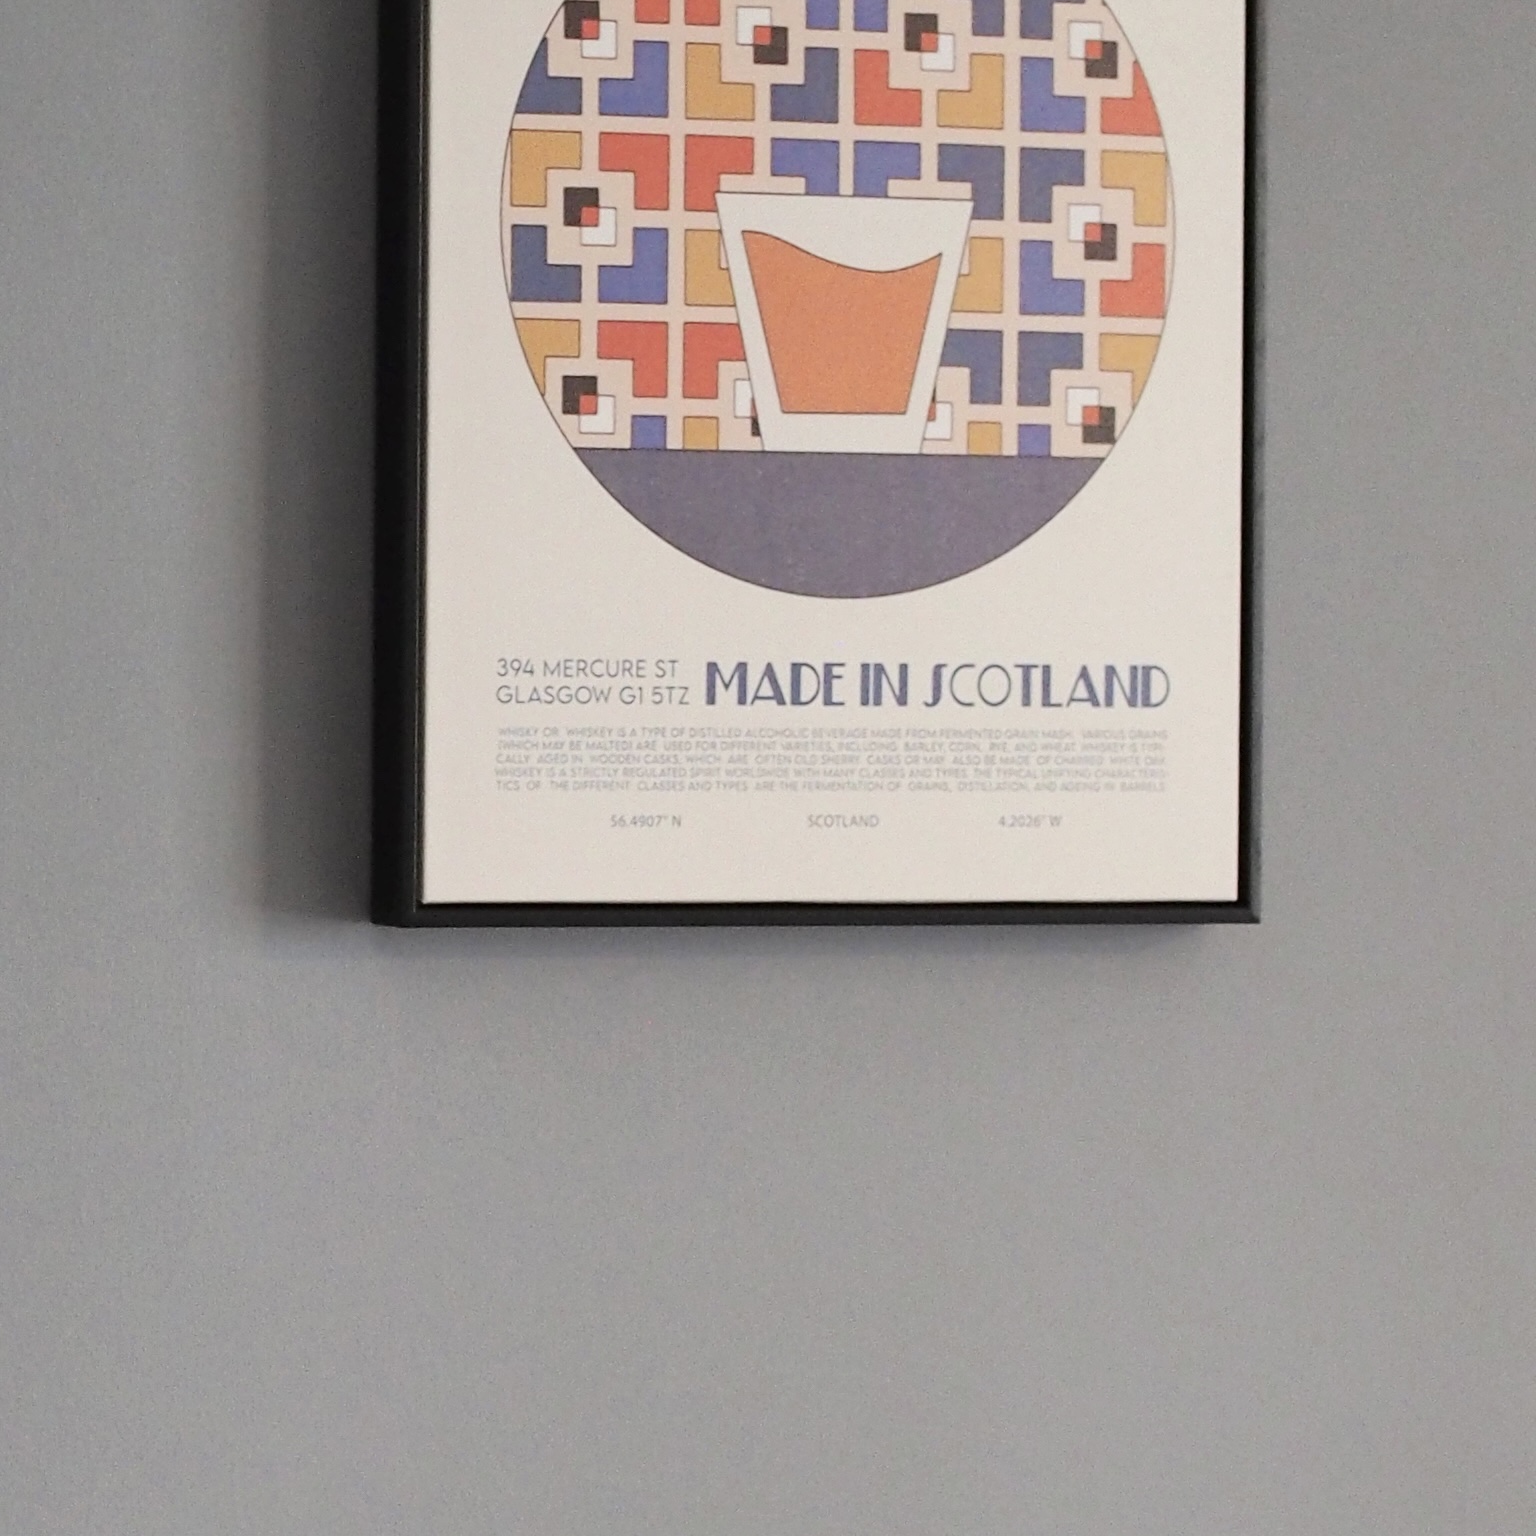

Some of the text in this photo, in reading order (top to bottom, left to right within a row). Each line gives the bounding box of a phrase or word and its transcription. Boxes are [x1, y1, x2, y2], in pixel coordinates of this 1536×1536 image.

[496, 657, 679, 679] 394 MERCURE ST
[496, 685, 690, 705] GLASGOW G1 5TZ
[705, 661, 1170, 709] MADE IN SCOTLAND
[671, 815, 682, 828] N
[807, 814, 880, 828] SCOTLAND
